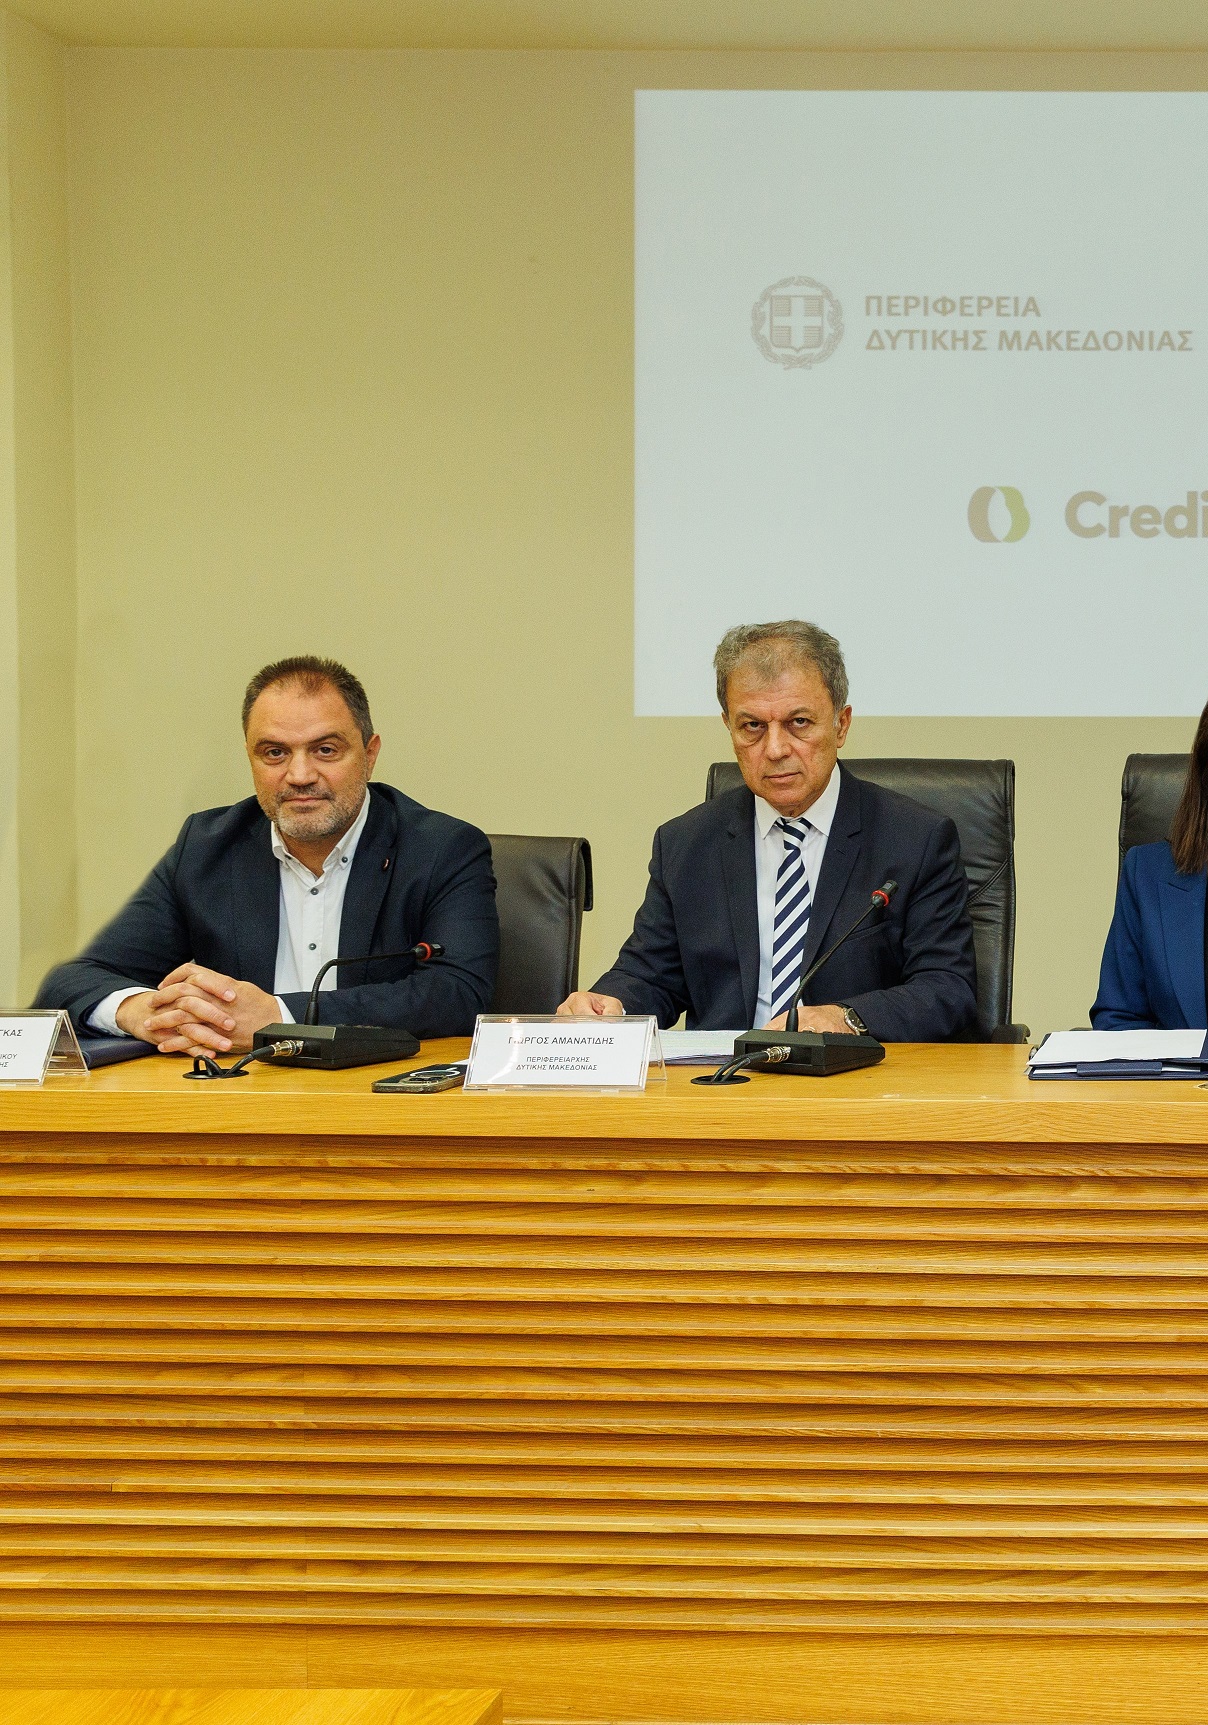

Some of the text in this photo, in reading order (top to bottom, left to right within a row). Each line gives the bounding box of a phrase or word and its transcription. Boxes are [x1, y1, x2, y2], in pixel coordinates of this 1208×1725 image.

[864, 295, 1042, 318] ΠΕΡΙΦΕΡΕΙΑ
[864, 329, 1193, 352] ΔΥΤΙΚΗΣ ΜΑΚΕΔΟΝΙΑΣ
[508, 1036, 615, 1045] ΓΩΡΓΟΣ ΑΜΑΝΑΤΙΔΗΣ
